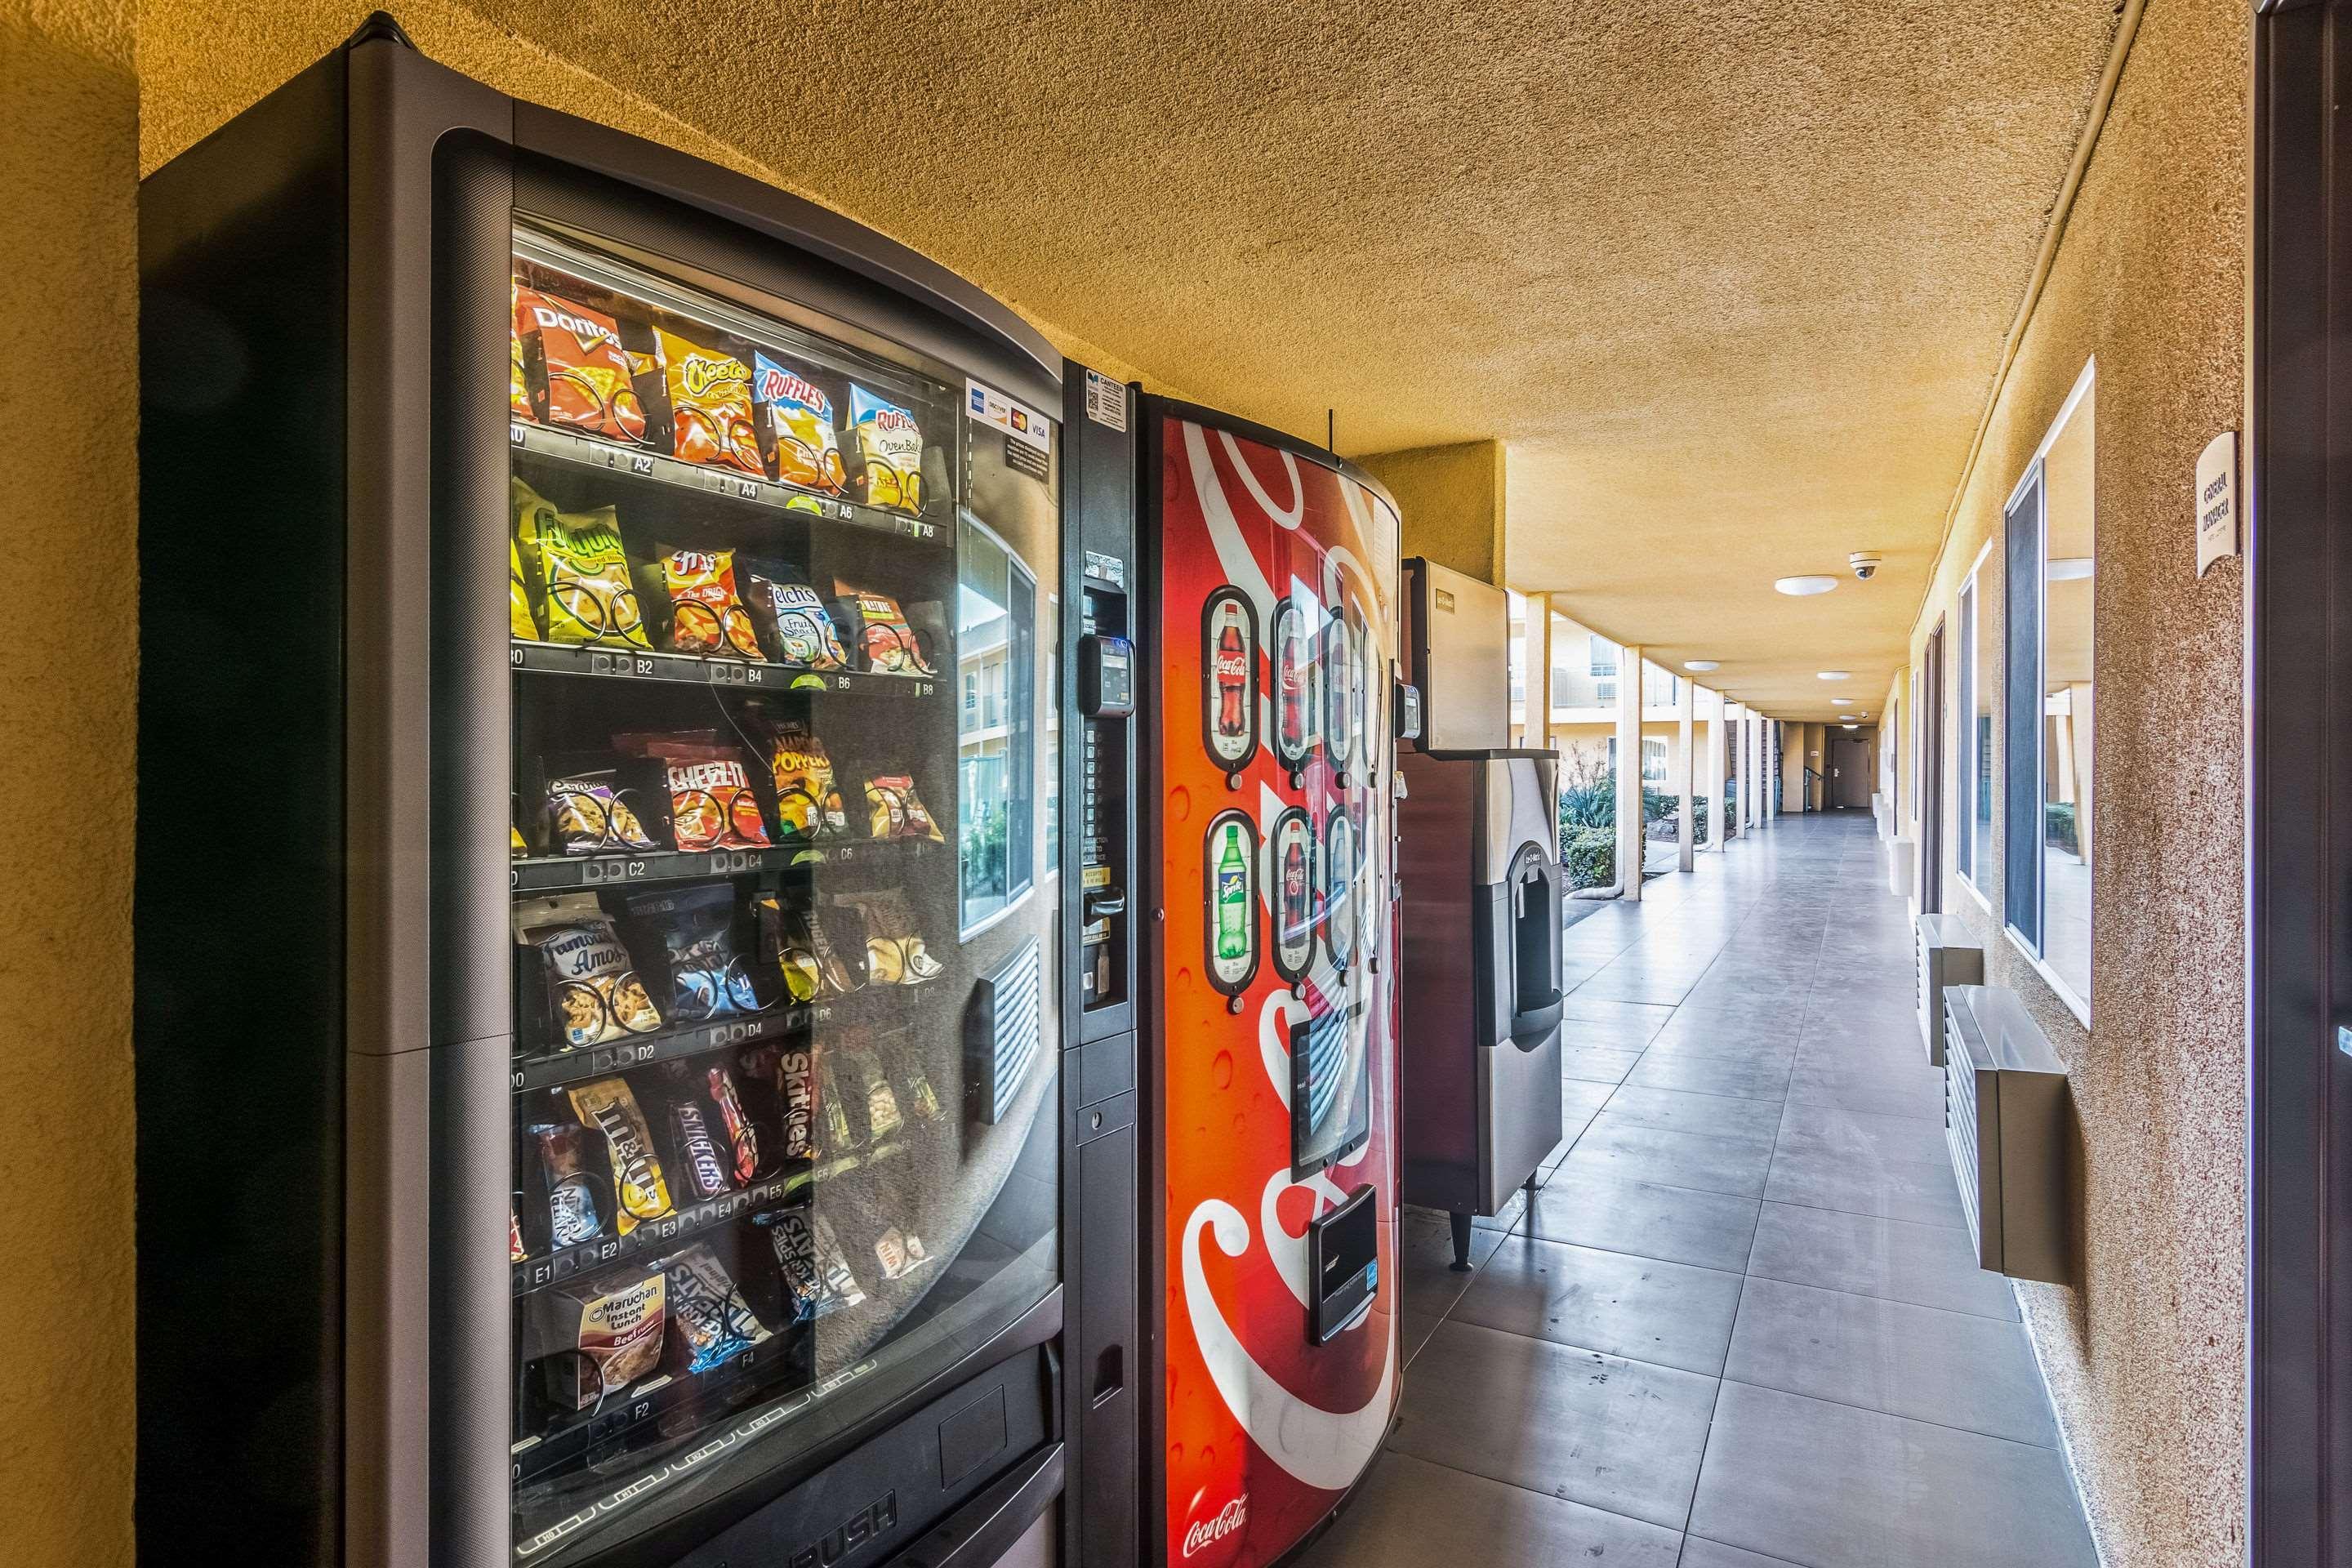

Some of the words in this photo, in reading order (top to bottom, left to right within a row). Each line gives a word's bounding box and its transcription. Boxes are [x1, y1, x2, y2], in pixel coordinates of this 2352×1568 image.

[532, 307, 622, 350] Doritos
[764, 370, 824, 411] RUFFLES
[1100, 378, 1123, 393] CANTEEN
[1032, 424, 1045, 439] VISA
[634, 457, 651, 473] A2
[741, 483, 756, 497] A4
[840, 505, 853, 519] A6
[923, 525, 933, 537] A8
[776, 586, 816, 605] elch's
[636, 660, 653, 675] B2
[748, 669, 762, 683] B4
[839, 677, 850, 689] B6
[923, 684, 933, 696] B8
[749, 854, 762, 868] C4
[841, 848, 853, 860] C6
[629, 862, 645, 876] C2
[572, 946, 626, 976] Amos
[819, 1009, 831, 1021] D6
[748, 1022, 762, 1037] D4
[638, 1045, 654, 1062] D2
[679, 1107, 722, 1189] SNICKERS
[817, 1169, 829, 1183] E6
[770, 1184, 782, 1199] E5
[719, 1204, 732, 1219] E4
[662, 1222, 678, 1238] E3
[601, 1242, 617, 1260] E2
[535, 1266, 550, 1284] E1
[603, 1286, 657, 1313] Maruchan
[607, 1303, 645, 1323] Instant
[611, 1314, 642, 1330] Lunch
[613, 1328, 637, 1347] Beef
[742, 1352, 755, 1368] F4
[635, 1402, 649, 1420] F2
[621, 1489, 632, 1499] H1
[1183, 1491, 1250, 1559] Coca-Cola
[542, 1531, 555, 1541] H0
